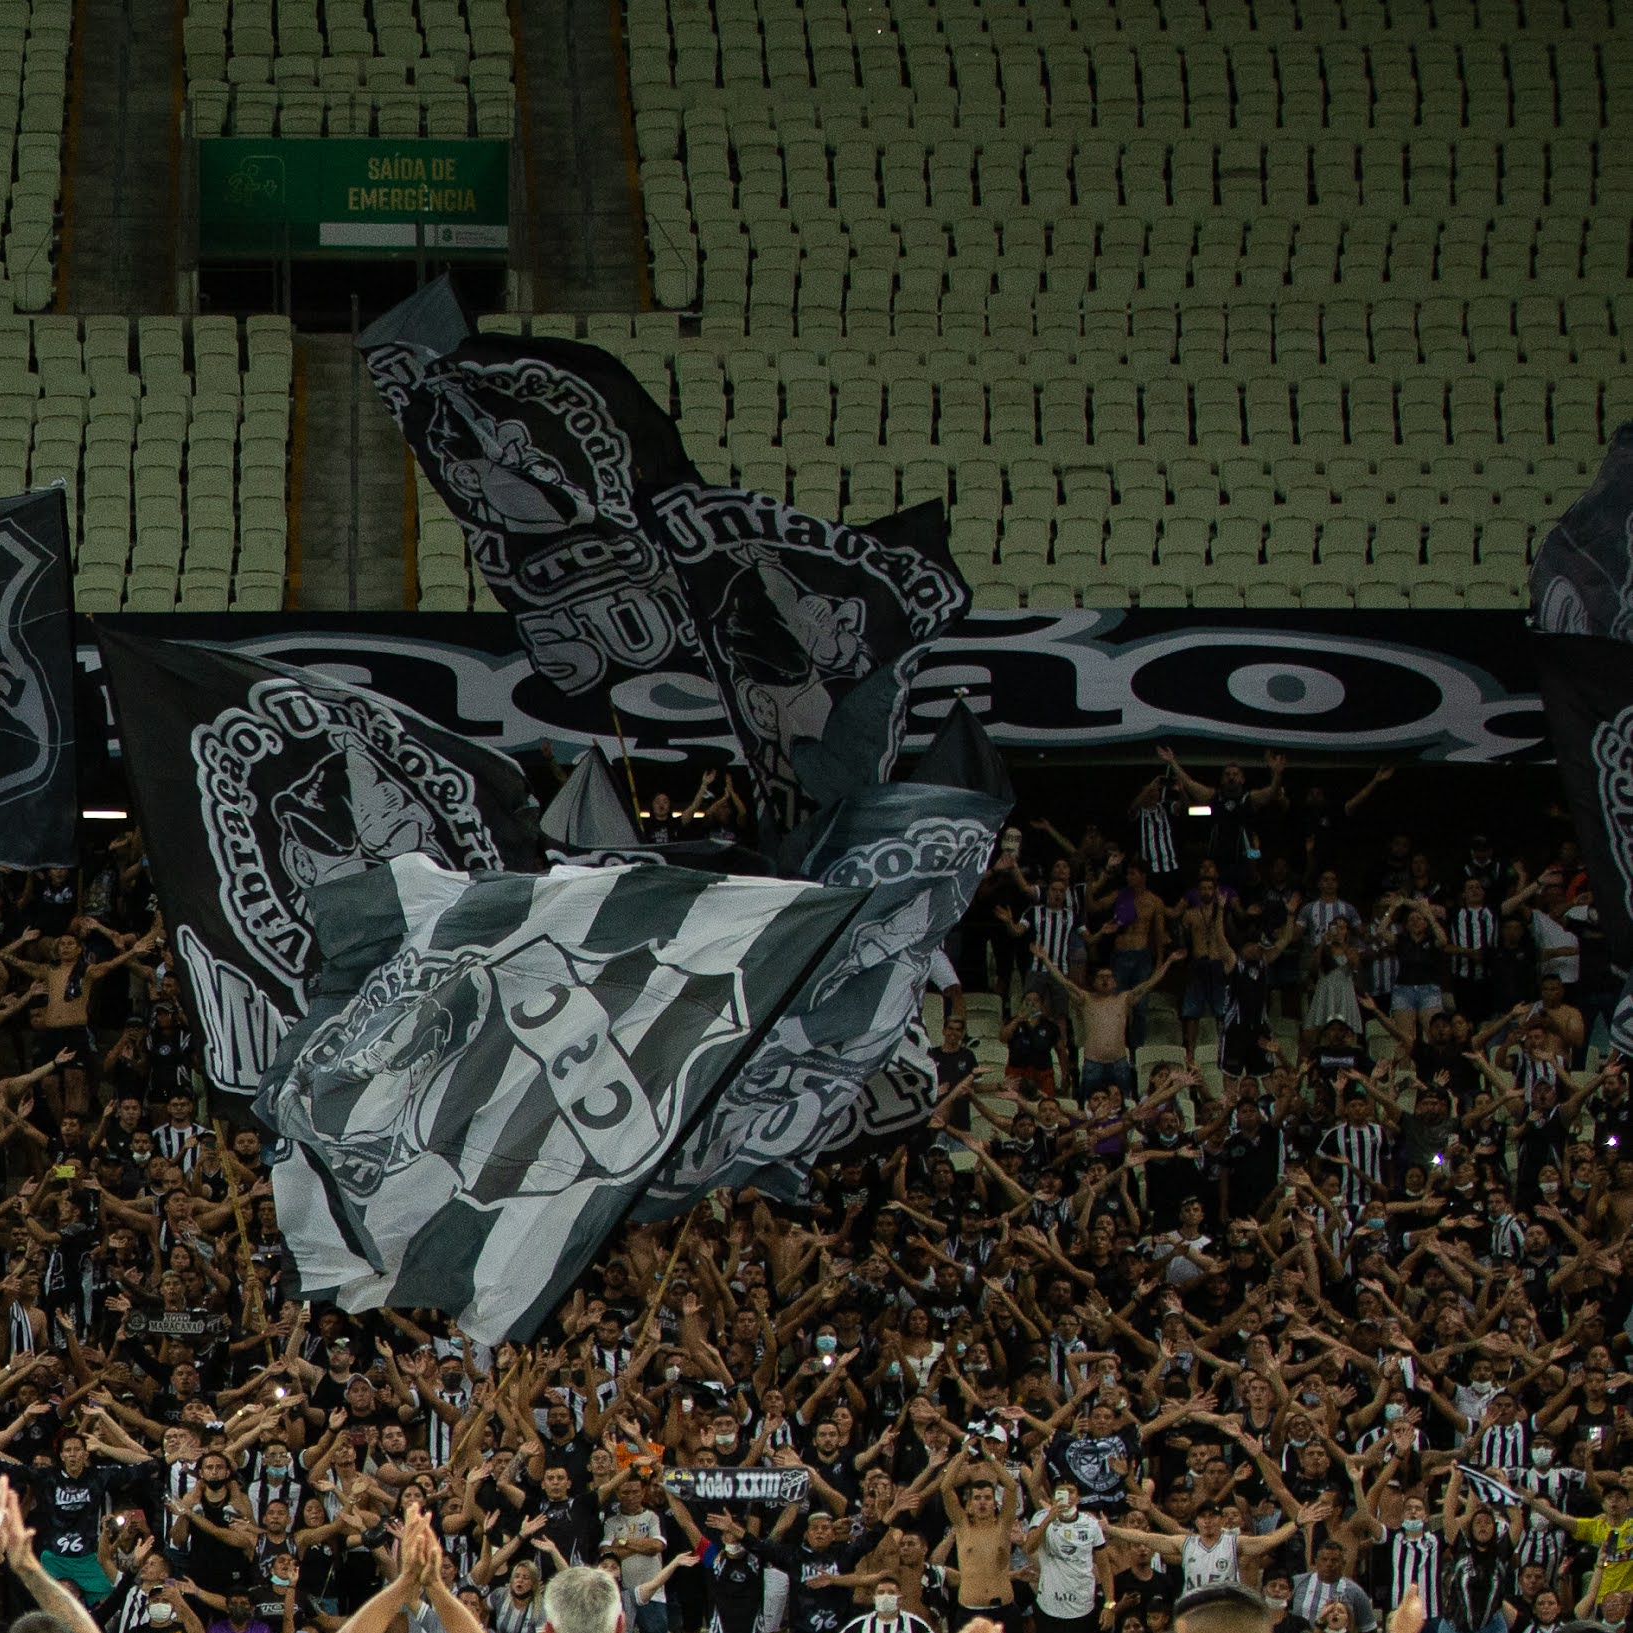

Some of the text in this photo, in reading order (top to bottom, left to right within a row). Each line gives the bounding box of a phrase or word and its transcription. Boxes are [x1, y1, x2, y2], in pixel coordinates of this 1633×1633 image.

[368, 153, 456, 181] SAÍDA DE
[347, 184, 477, 212] EMERGÊNCIA
